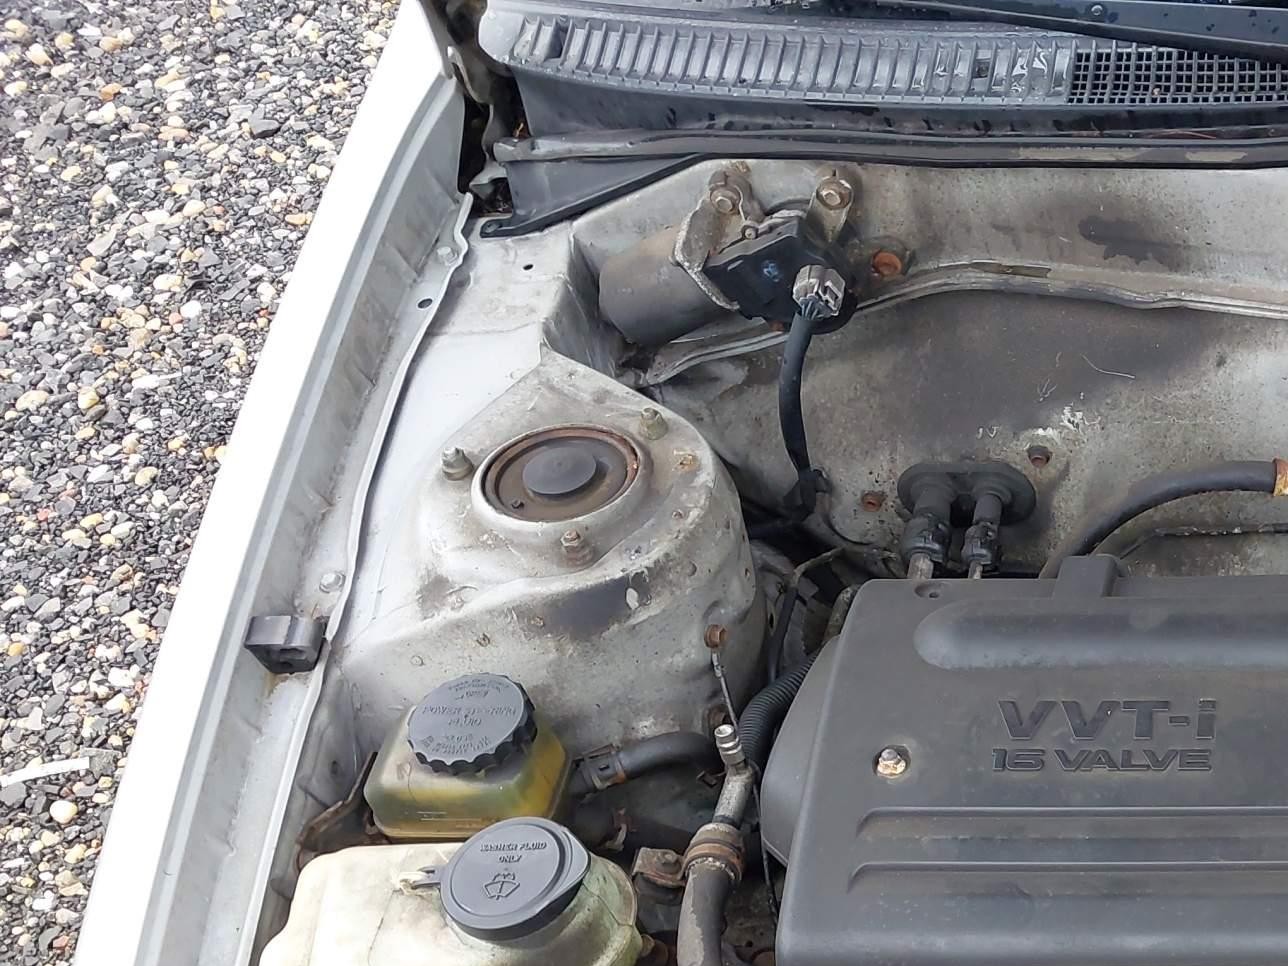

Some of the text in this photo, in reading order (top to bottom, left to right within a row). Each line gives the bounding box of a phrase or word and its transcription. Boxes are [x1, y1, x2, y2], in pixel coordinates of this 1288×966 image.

[997, 698, 1218, 741] VVT-i
[992, 747, 1213, 772] 16 VALVE
[480, 840, 547, 853] WASHER FLUID
[498, 855, 523, 864] ONLY
